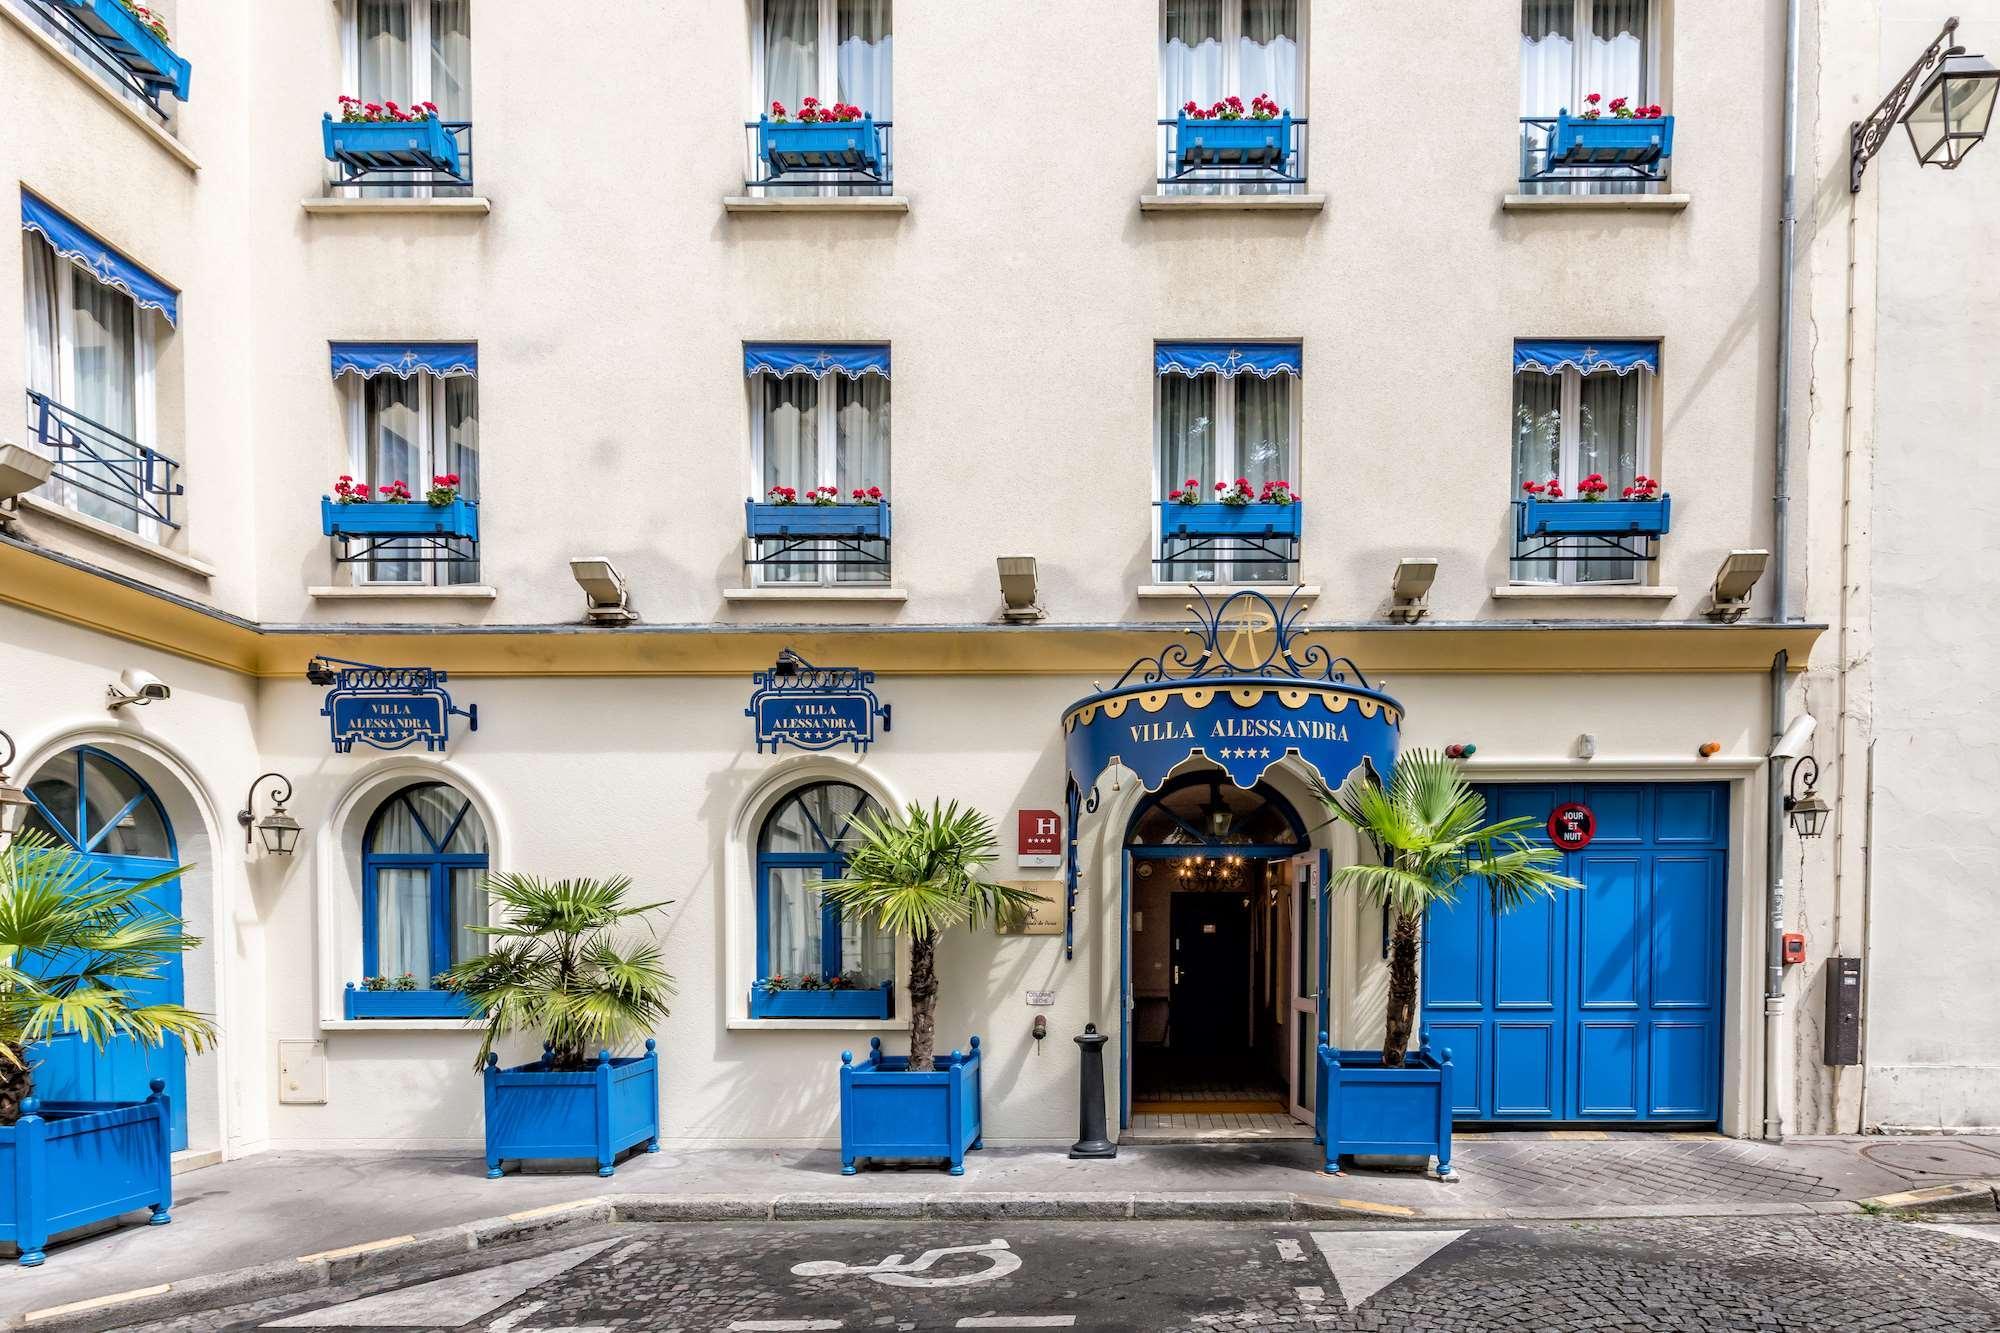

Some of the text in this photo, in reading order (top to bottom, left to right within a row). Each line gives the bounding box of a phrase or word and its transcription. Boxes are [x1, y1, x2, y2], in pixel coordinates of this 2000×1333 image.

[371, 704, 411, 714] VILLA
[795, 705, 837, 715] VILLA
[349, 718, 431, 728] ALESSANDRA
[773, 718, 856, 728] ALESSANDRA
[1130, 718, 1349, 743] VILLA ALESSANDRA
[1563, 812, 1584, 820] JOUR
[1036, 818, 1057, 835] H
[1568, 822, 1578, 830] ET
[1563, 832, 1582, 840] NUIT
